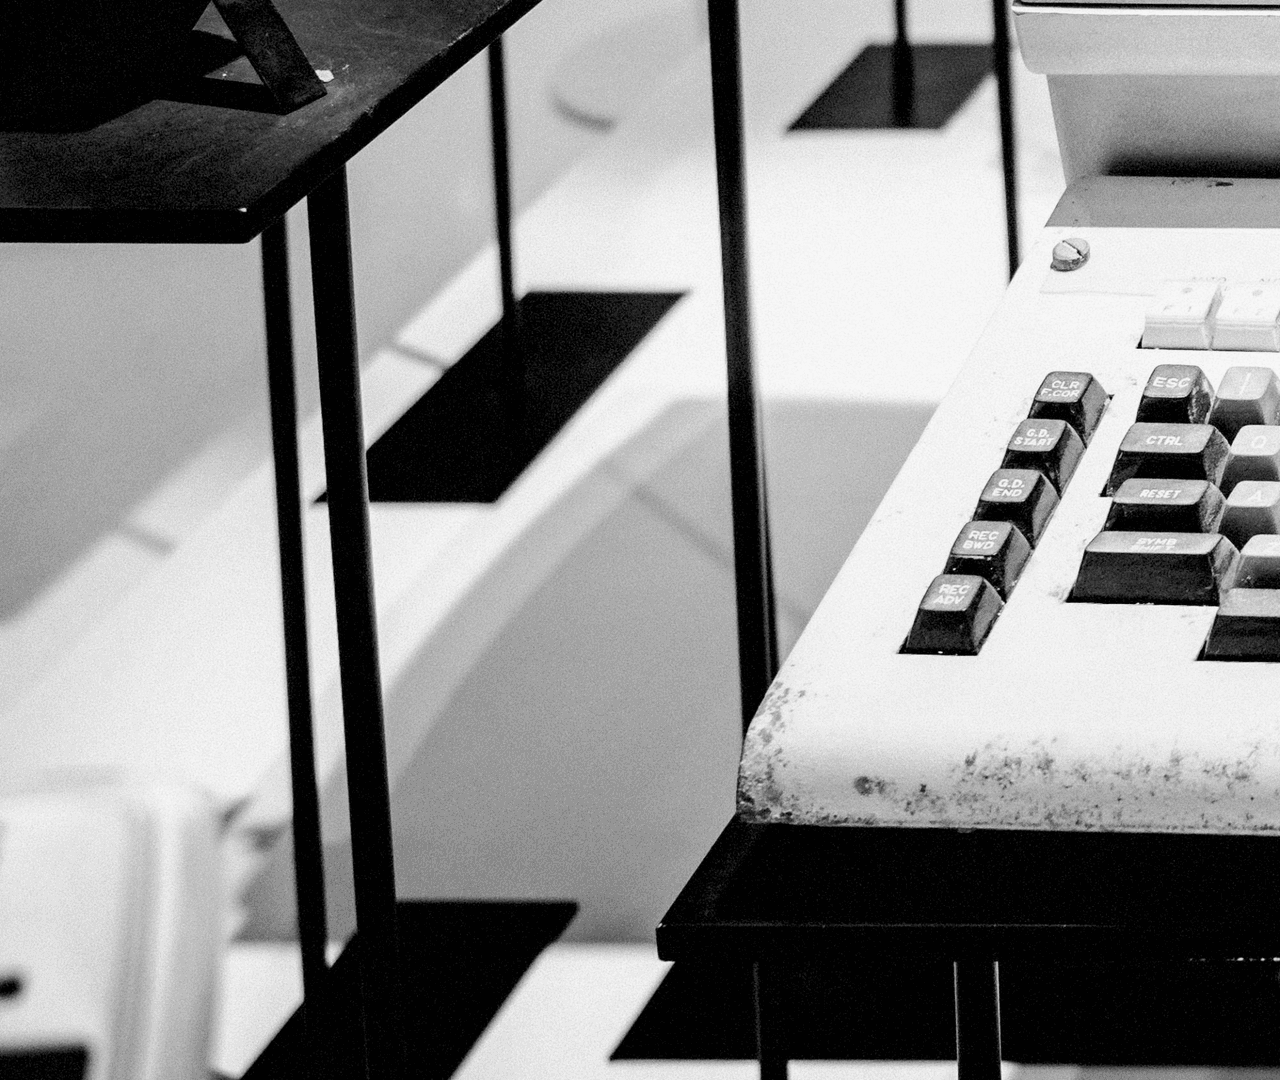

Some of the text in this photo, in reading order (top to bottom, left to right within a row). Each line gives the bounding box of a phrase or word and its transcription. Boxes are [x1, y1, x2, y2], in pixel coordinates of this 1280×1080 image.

[1052, 380, 1080, 389] CLR
[1152, 377, 1192, 389] ESC
[1040, 388, 1080, 398] F.COR
[1026, 428, 1051, 438] G.D.
[1014, 437, 1056, 446] START
[1146, 435, 1183, 446] CTRL
[1250, 435, 1267, 449] Q
[998, 479, 1025, 489] G.D.
[991, 489, 1023, 497] END
[1139, 489, 1182, 499] RESET
[1247, 489, 1262, 503] A
[968, 530, 1000, 541] REC
[962, 540, 995, 550] BWD
[1136, 537, 1178, 546] SYMB
[938, 583, 970, 595] REC
[933, 595, 965, 605] ADV
